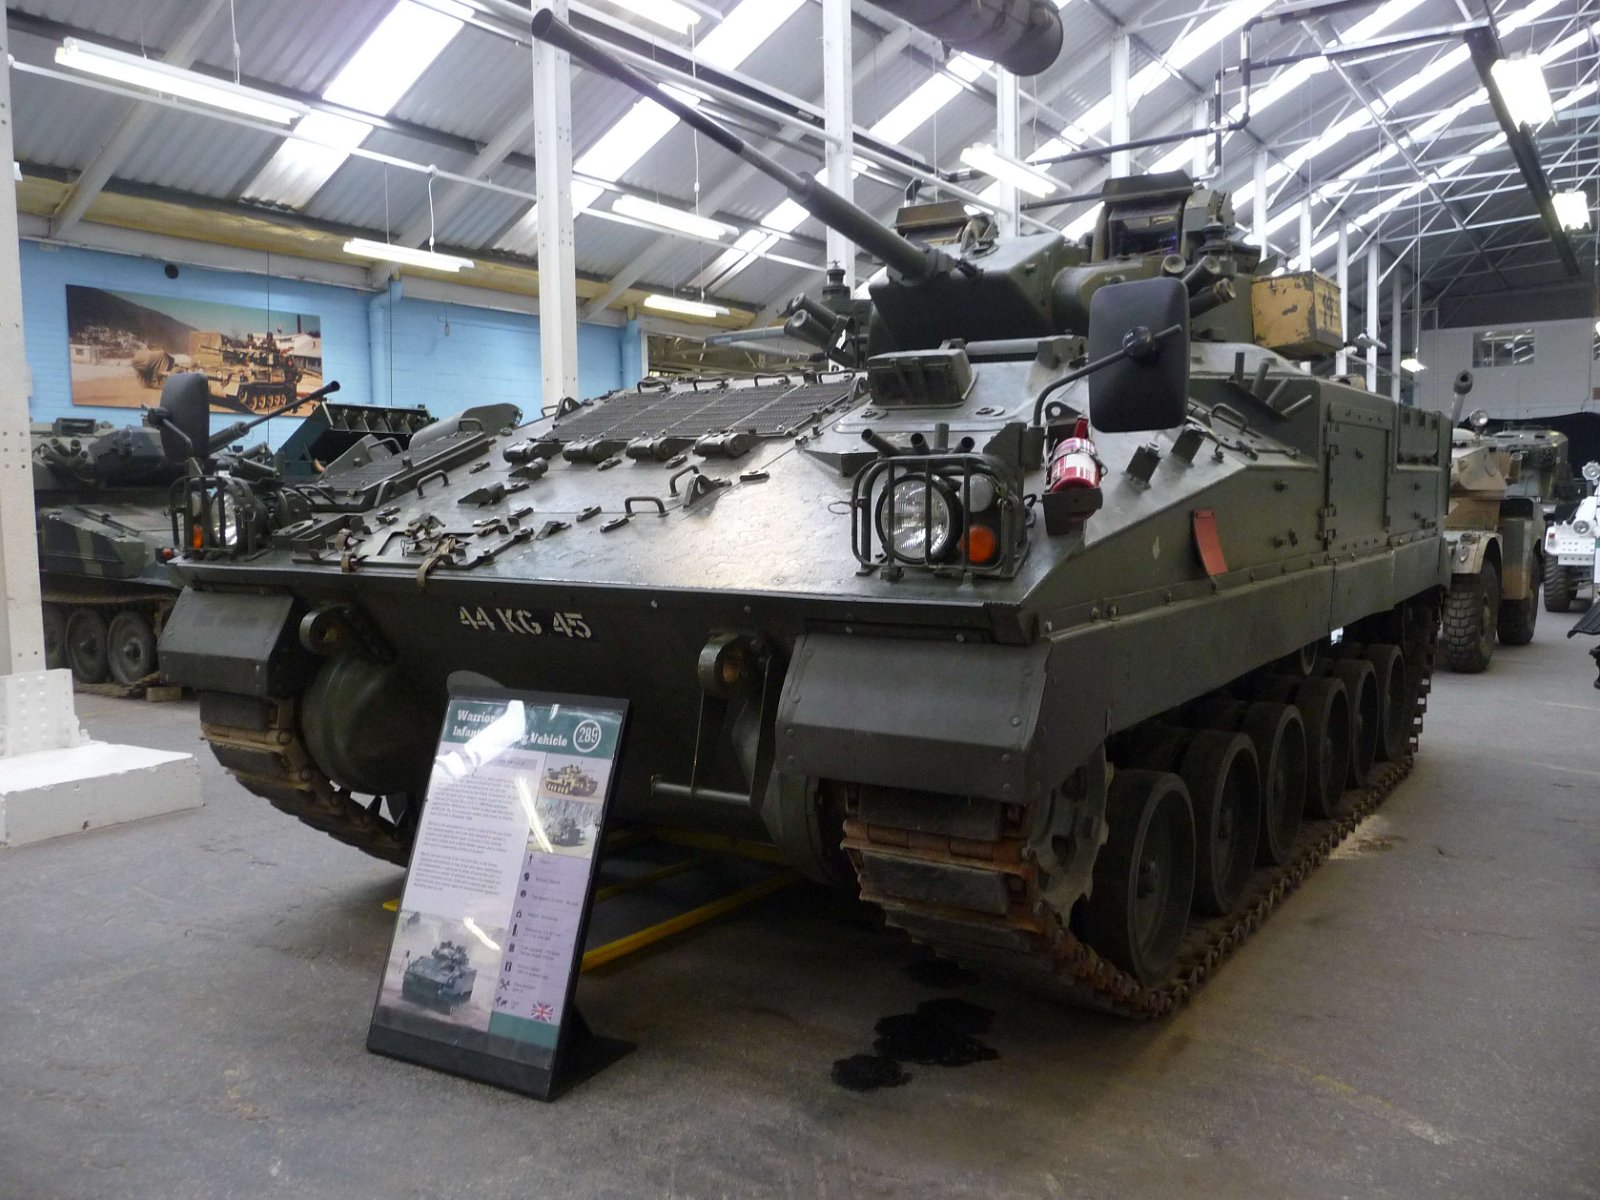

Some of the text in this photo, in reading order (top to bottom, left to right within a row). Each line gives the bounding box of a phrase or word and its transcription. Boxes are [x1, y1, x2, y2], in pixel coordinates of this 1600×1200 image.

[459, 605, 592, 639] 44 KG 45
[457, 708, 496, 723] Warrior
[530, 731, 568, 747] Vehicle
[577, 726, 599, 744] 289
